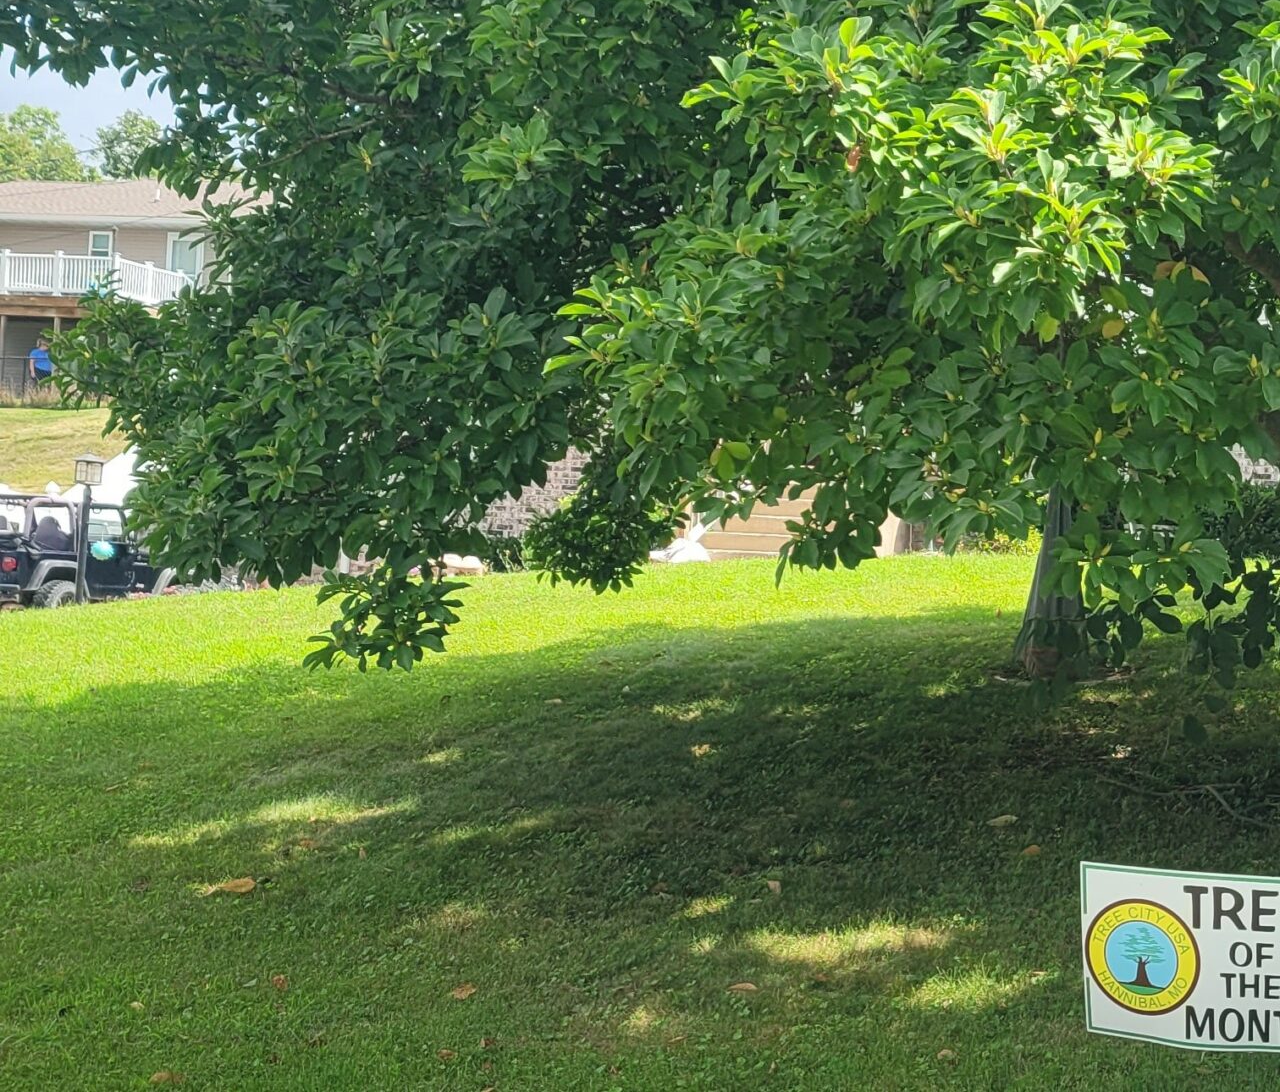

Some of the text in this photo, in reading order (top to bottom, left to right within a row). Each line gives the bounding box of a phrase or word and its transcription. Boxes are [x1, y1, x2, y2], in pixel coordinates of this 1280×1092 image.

[1093, 906, 1191, 955] TREE CITY USA
[1229, 942, 1275, 968] OF
[1097, 970, 1188, 1008] HANNIBAL, MO
